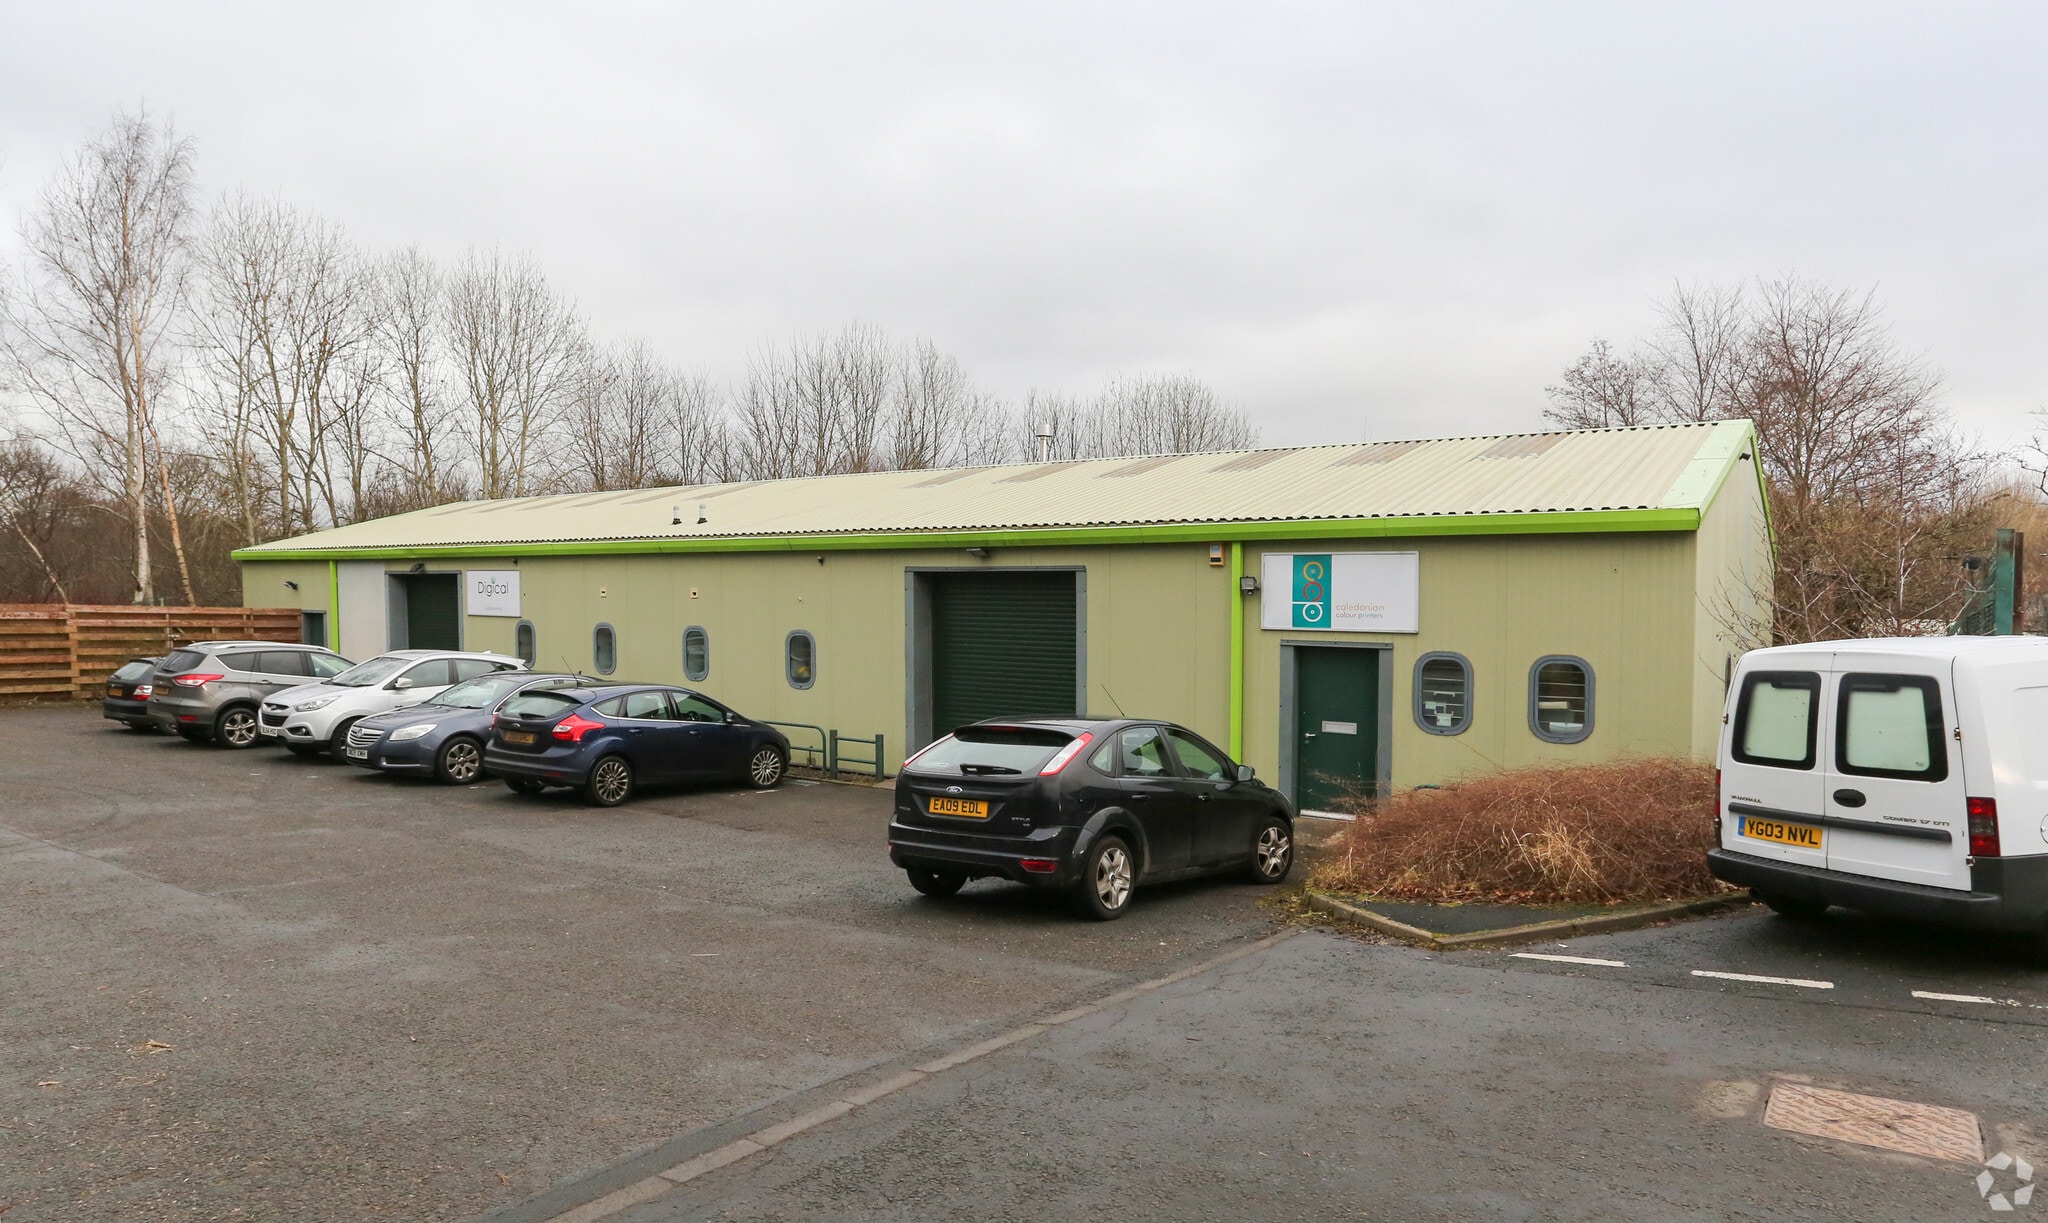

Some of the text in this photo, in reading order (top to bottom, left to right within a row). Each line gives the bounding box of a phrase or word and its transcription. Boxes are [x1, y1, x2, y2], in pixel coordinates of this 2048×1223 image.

[477, 580, 509, 597] Digical
[1336, 603, 1384, 612] caledonian
[1357, 612, 1383, 620] printers
[933, 799, 982, 814] EA09 EDL
[1747, 820, 1818, 845] YG03 NVL
